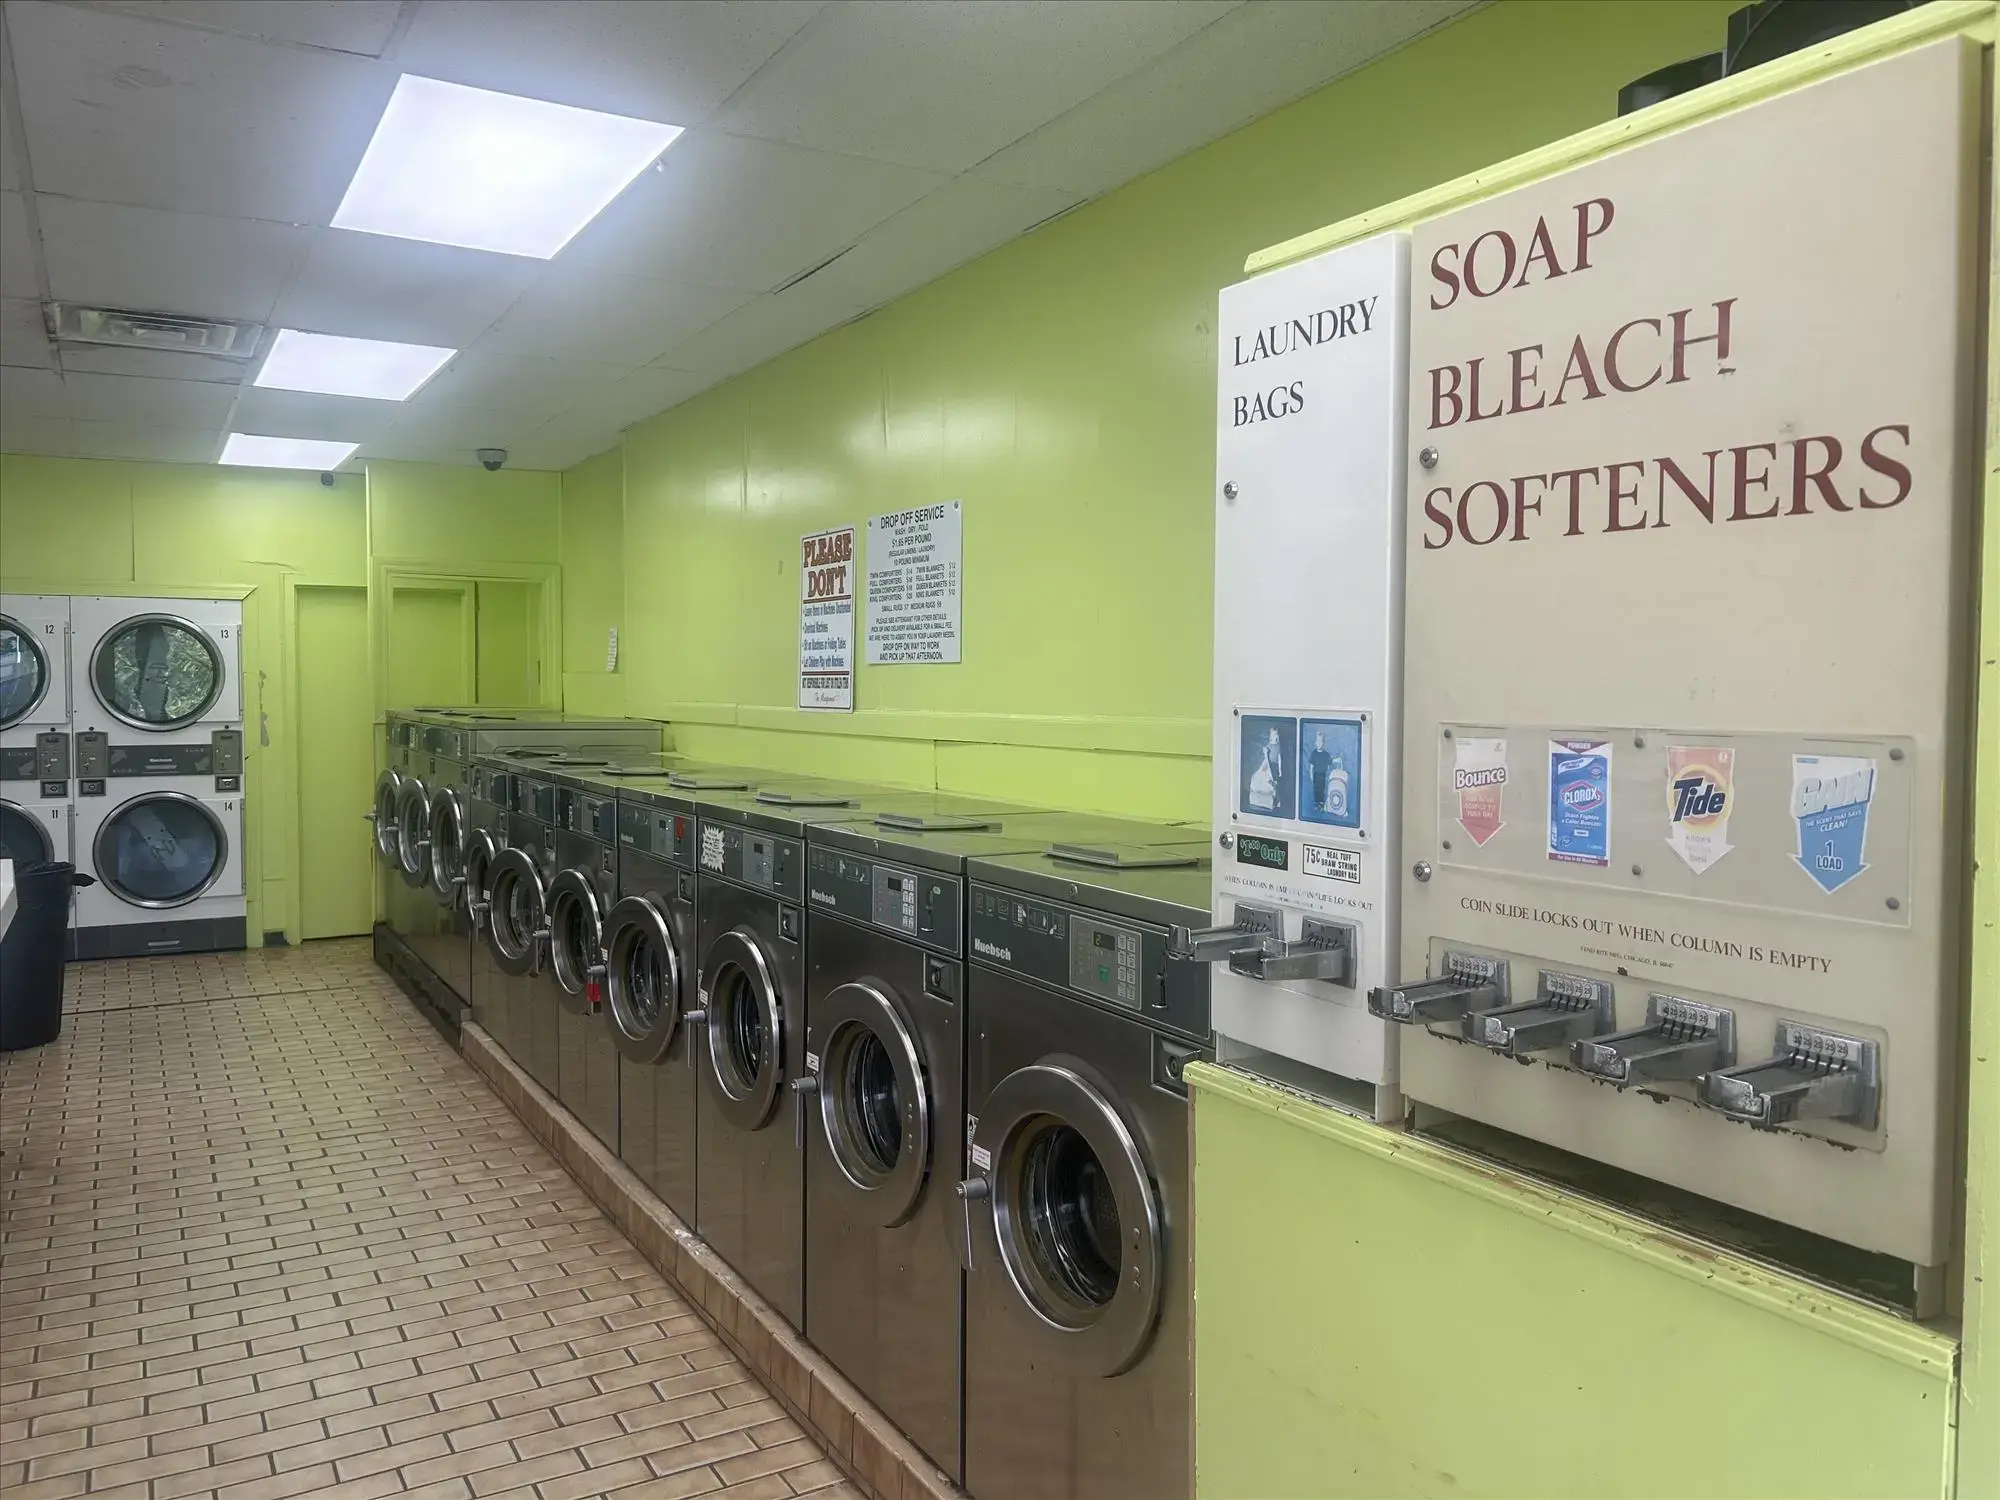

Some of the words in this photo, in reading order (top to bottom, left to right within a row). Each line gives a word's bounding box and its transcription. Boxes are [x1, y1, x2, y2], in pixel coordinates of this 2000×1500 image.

[1429, 197, 1615, 311] SOAP
[1233, 296, 1379, 367] LAUNDRY
[1427, 298, 1739, 429] BLEACH
[1232, 381, 1305, 428] BAGS
[1423, 424, 1912, 549] SOFTENERS
[881, 515, 899, 529] DROP
[900, 512, 913, 525] OFF
[915, 505, 944, 523] SERVICE
[905, 536, 914, 545] PER
[915, 533, 932, 544] POUND
[804, 533, 852, 568] PLEASE
[926, 564, 945, 572] BLANKETS
[926, 572, 944, 580] BLANKETS
[808, 565, 846, 597] DON'T
[45, 625, 54, 634] 12
[221, 630, 228, 638] 13
[883, 643, 894, 651] DROP
[899, 652, 904, 660] UP
[906, 652, 916, 660] THAT
[1456, 767, 1506, 789] Bounce
[1565, 788, 1596, 804] CLOROX
[1673, 778, 1726, 822] Tide
[52, 810, 58, 818] 11
[1820, 819, 1848, 832] CLEAN!
[1261, 844, 1286, 865] Only
[1306, 848, 1321, 864] 75¢
[1825, 840, 1835, 856] 1
[1340, 853, 1351, 861] TUFF
[1816, 855, 1843, 870] LOAD
[1327, 868, 1347, 879] LAUNDRY
[1348, 872, 1357, 880] BAG
[1338, 861, 1357, 872] STRING
[1460, 897, 1492, 915] COIN
[1495, 902, 1529, 920] SLIDE
[1534, 909, 1578, 929] LOCKS
[1582, 918, 1613, 934] OUT
[1618, 924, 1665, 944] WHEN
[1670, 933, 1742, 959] COLUMN
[1748, 946, 1763, 962] IS
[1770, 949, 1832, 974] EMPTY
[974, 937, 1011, 961] Huebsch
